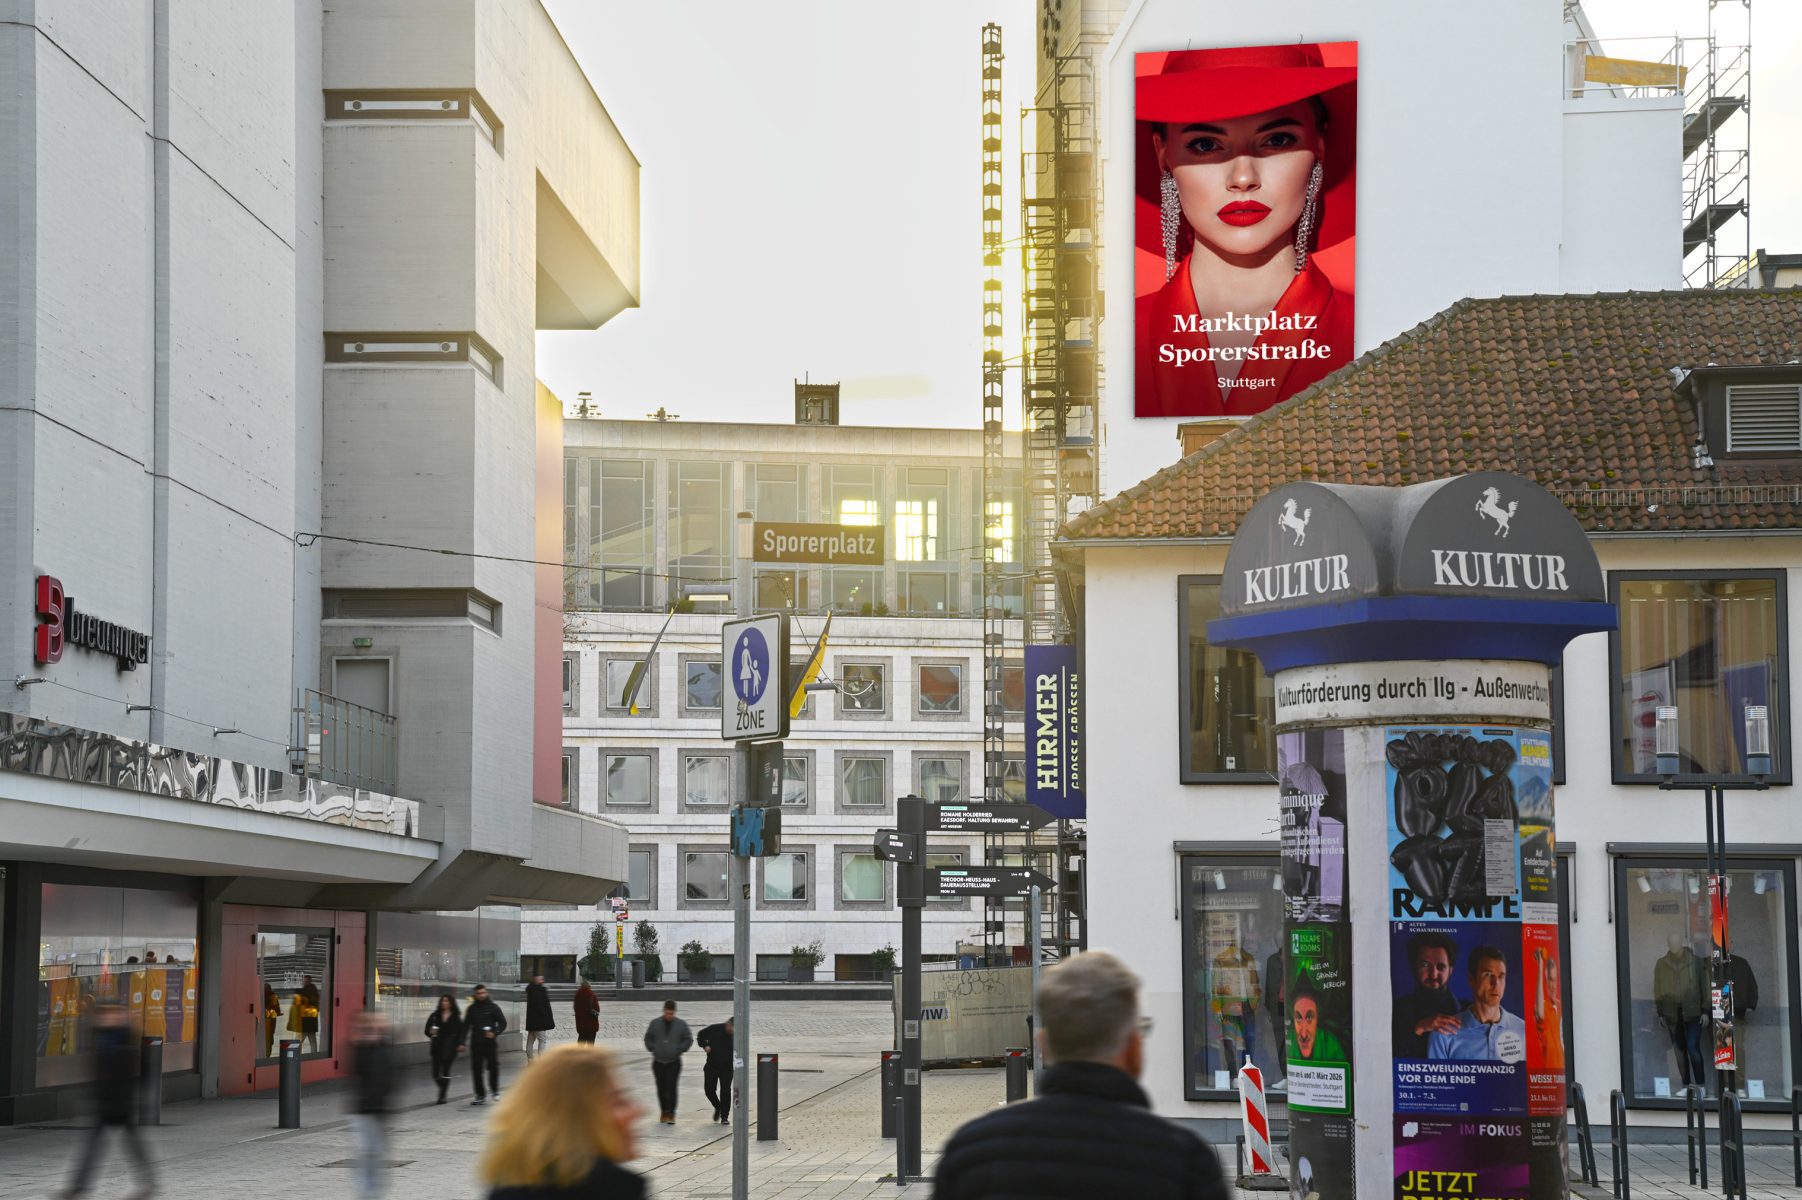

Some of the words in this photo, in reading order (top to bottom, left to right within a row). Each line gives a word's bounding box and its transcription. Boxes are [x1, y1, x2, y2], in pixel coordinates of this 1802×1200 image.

[1173, 310, 1318, 336] Marktplatz
[1159, 338, 1332, 367] Sporerstraße
[1217, 376, 1276, 390] Stuttgart
[763, 529, 876, 559] Sporerplatz
[1243, 554, 1351, 605] KULTUR
[1431, 550, 1570, 591] KULTUR
[64, 596, 153, 671] breuninger
[1278, 681, 1371, 708] Kulturförderung
[1377, 677, 1427, 699] durch
[1433, 676, 1455, 700] Ilg
[736, 710, 765, 731] ZONE
[1036, 673, 1059, 790] HIRMER
[1316, 1072, 1328, 1080] März
[1329, 1072, 1343, 1081] 2026
[1398, 1063, 1515, 1074] EINSZWEIUNDZWANZIG
[1398, 1074, 1421, 1083] VOR
[1424, 1075, 1447, 1083] DEM
[1450, 1076, 1476, 1084] ENDE
[1529, 1074, 1552, 1084] WEISSE
[1423, 1092, 1437, 1100] 7.3.
[1460, 1124, 1475, 1136] IM
[1479, 1124, 1522, 1137] FOKUS
[1401, 1170, 1478, 1193] JETZT
